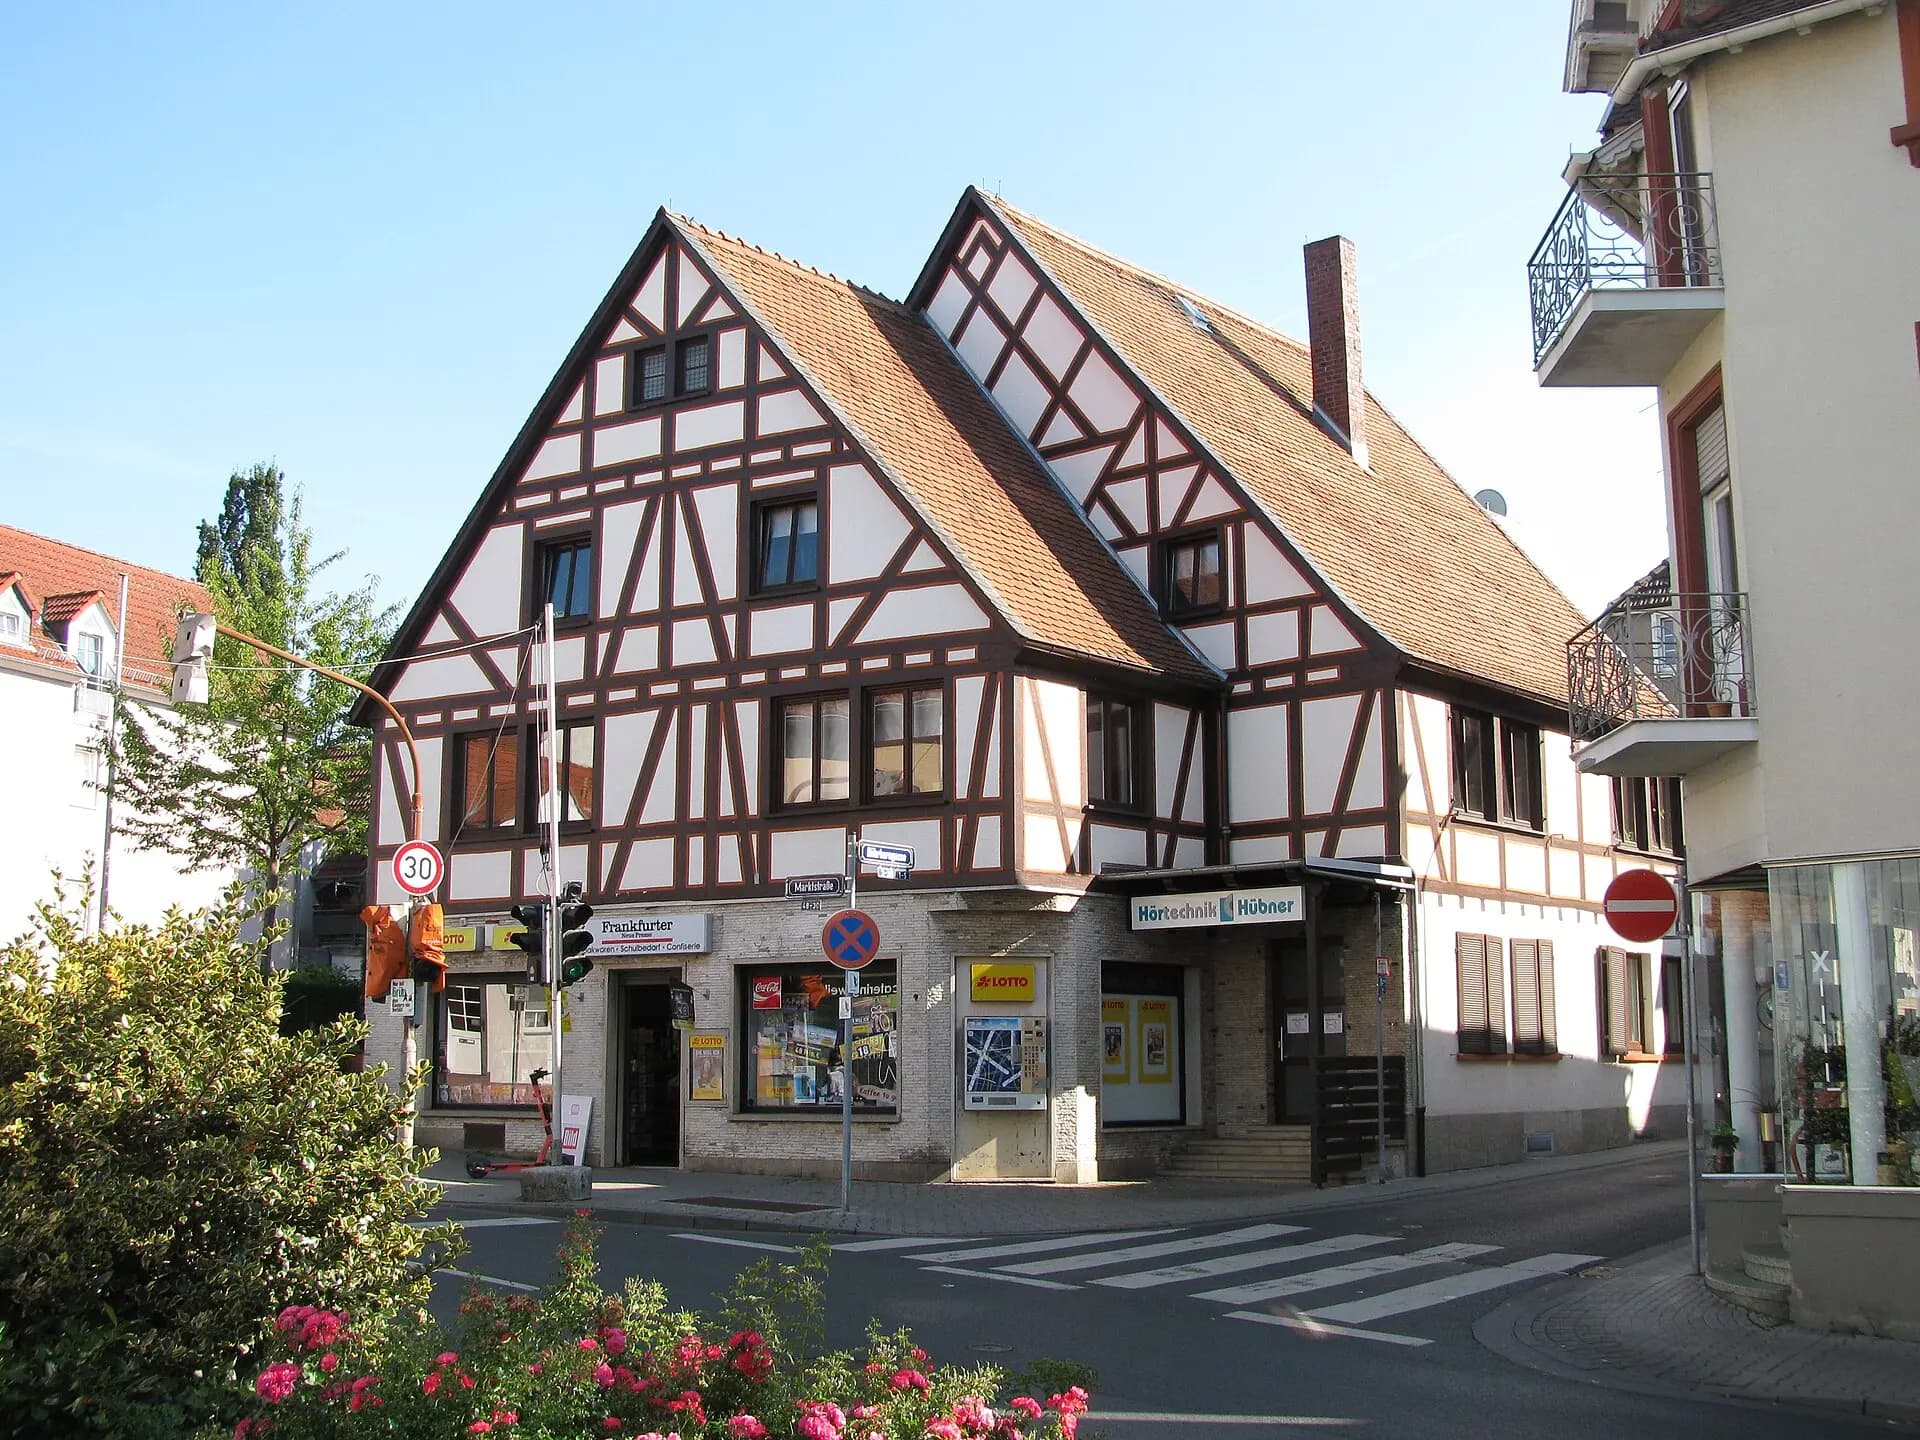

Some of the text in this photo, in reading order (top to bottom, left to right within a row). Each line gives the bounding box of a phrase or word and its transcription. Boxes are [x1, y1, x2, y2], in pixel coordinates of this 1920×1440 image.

[404, 856, 431, 880] 30
[794, 881, 834, 893] Marktstraße
[1138, 898, 1294, 922] Hörtechnik Hübner
[602, 920, 673, 933] Frankfurter
[443, 934, 465, 944] OTTO
[586, 946, 615, 954] akwaren
[666, 942, 701, 951] Confiserie
[992, 976, 1028, 987] LOTTO
[700, 1037, 722, 1045] LOTTO
[857, 1045, 869, 1057] 18
[563, 1130, 579, 1147] Bild
